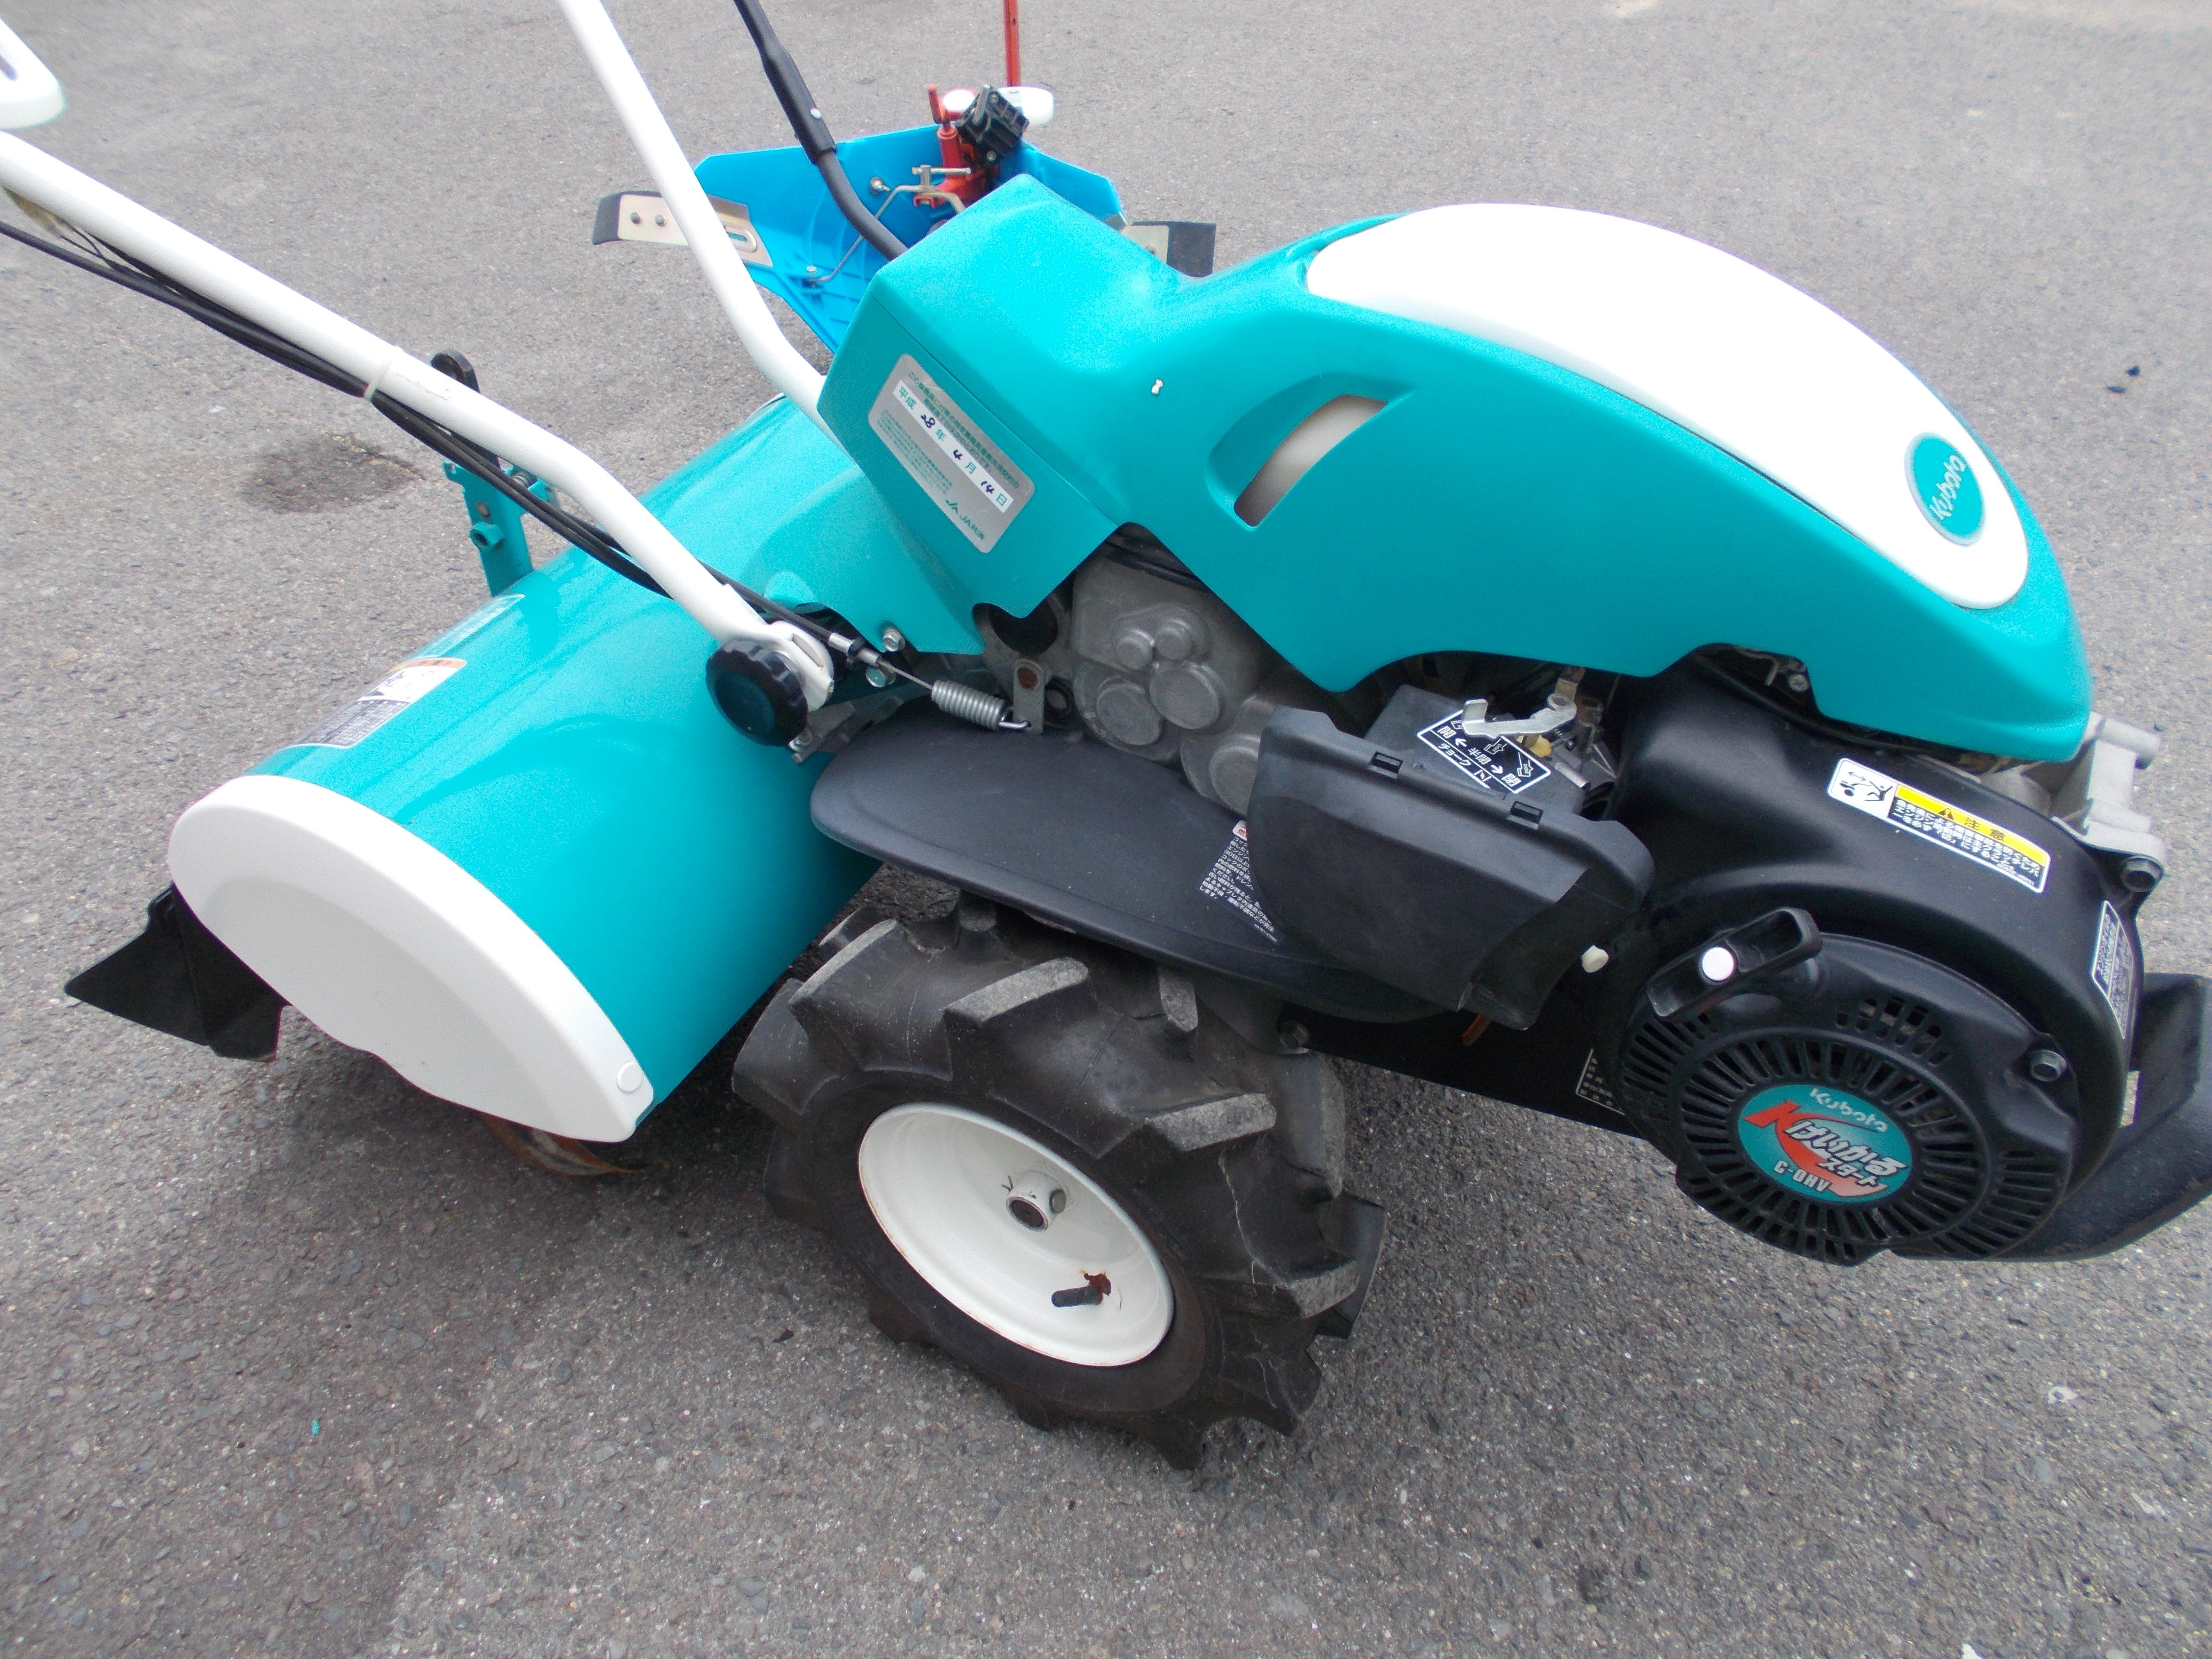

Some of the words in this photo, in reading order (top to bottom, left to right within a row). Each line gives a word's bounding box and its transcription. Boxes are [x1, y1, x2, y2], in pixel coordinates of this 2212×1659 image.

[899, 386, 916, 409] 平成
[920, 414, 936, 429] 28
[936, 429, 947, 441] 年
[953, 450, 963, 460] 4
[964, 461, 976, 474] 月
[980, 481, 995, 494] 14
[996, 493, 1007, 506] 日
[1929, 455, 1966, 520] Kubota
[1437, 726, 1456, 738] 開
[1438, 743, 1471, 766] チョーク
[1964, 817, 2006, 842] 注意
[1224, 849, 1250, 868] 30日以上
[1200, 886, 1217, 900] します。
[1810, 1088, 1888, 1132] Kubota
[1784, 1121, 1908, 1176] けいかる
[1817, 1157, 1880, 1188] スタート
